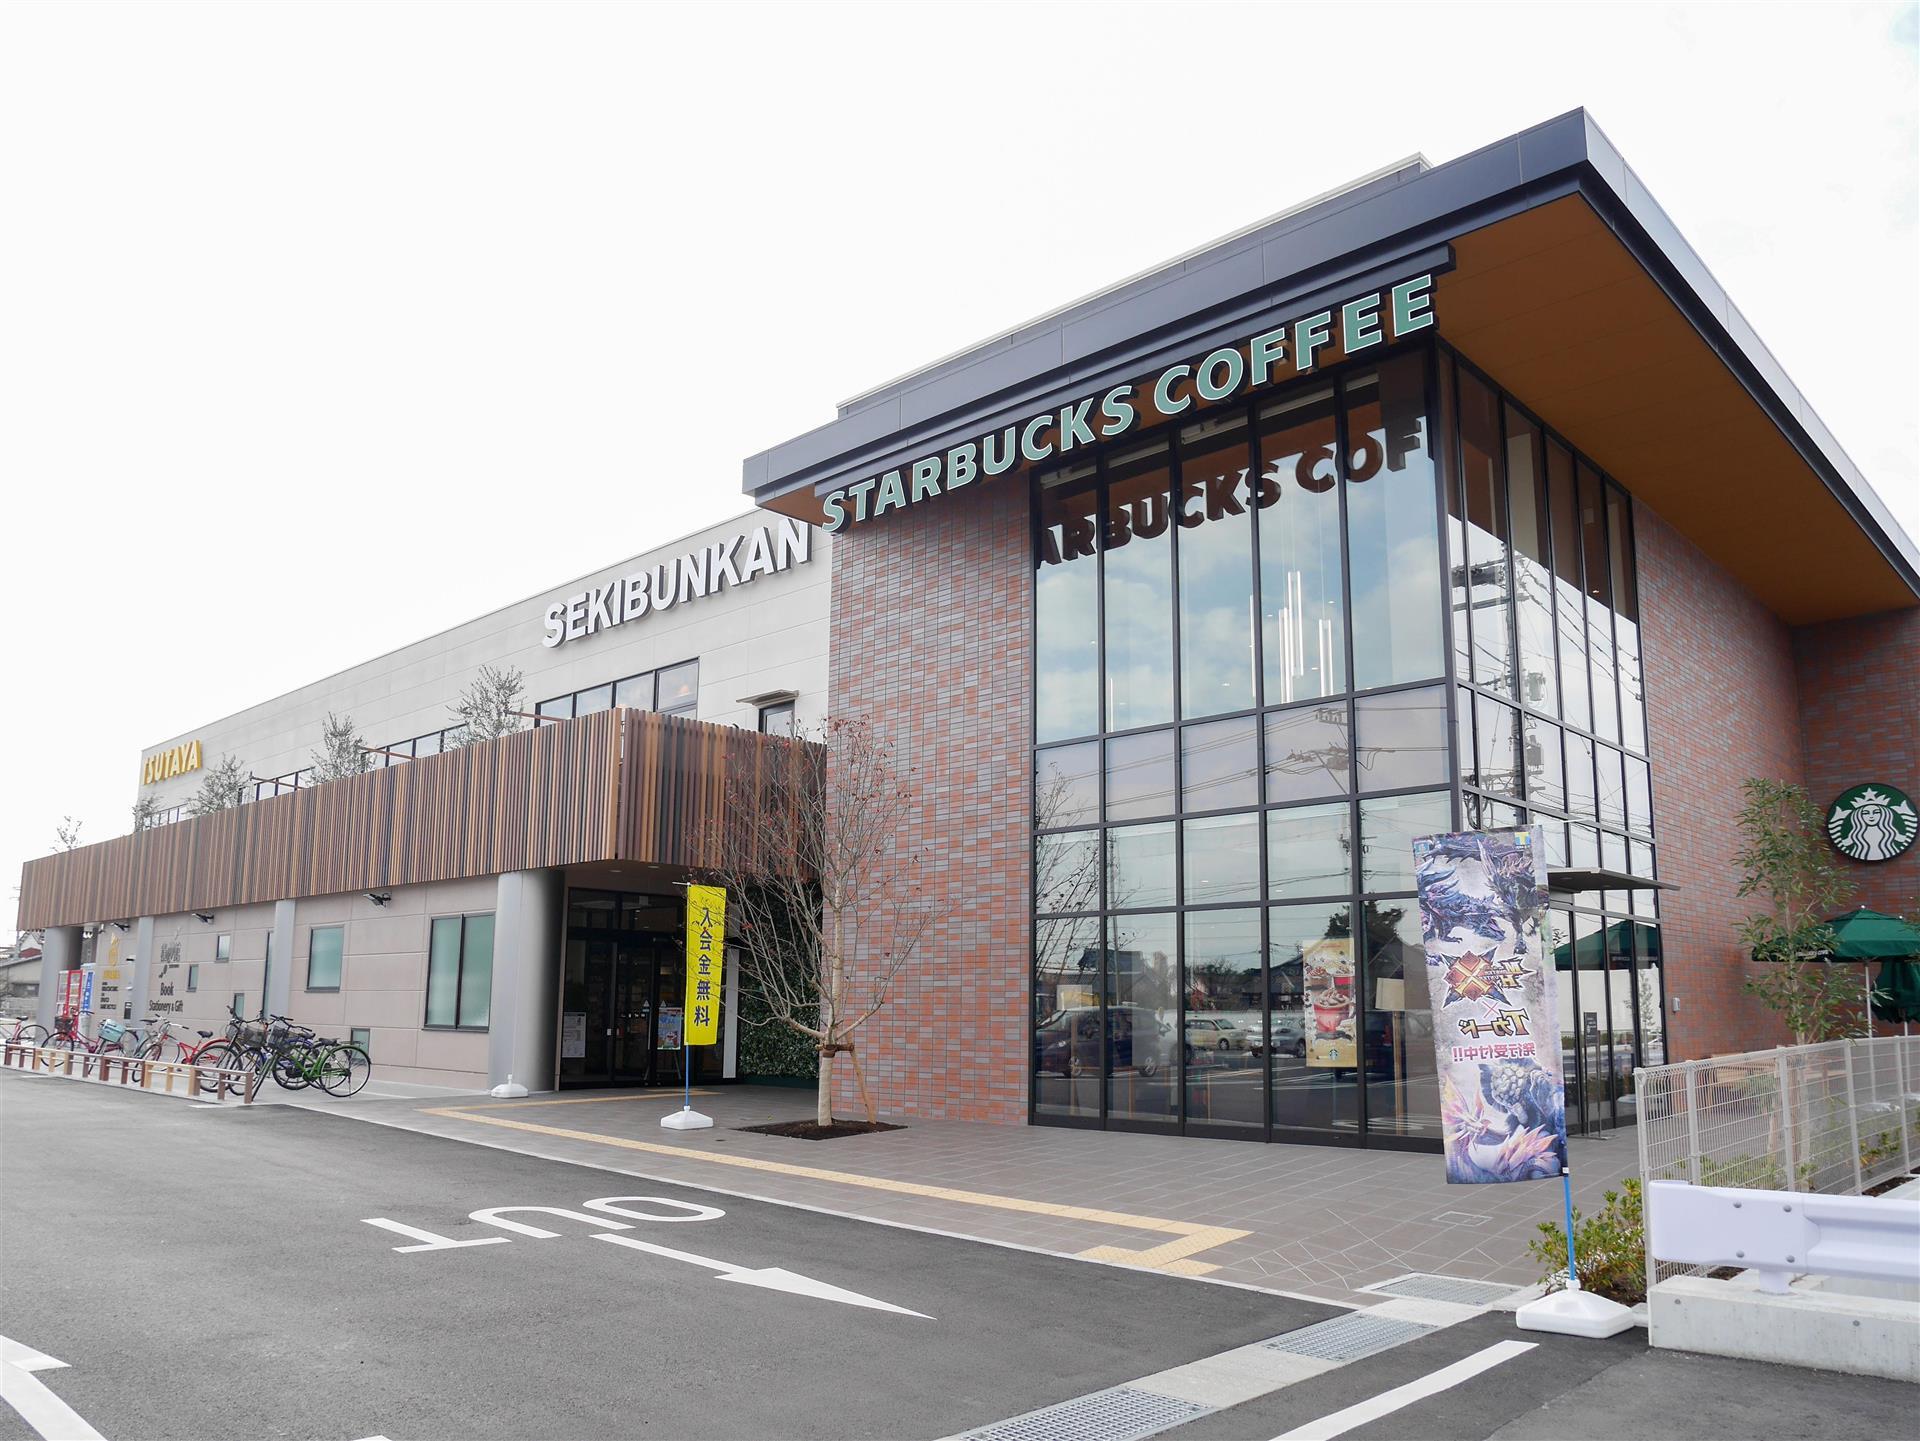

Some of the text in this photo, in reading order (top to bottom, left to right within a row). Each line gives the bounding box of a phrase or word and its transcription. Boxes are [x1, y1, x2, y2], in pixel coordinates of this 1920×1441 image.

[820, 273, 1436, 534] STARBUCKS COFFEE
[541, 518, 813, 649] SEKIBUNKAN
[160, 982, 175, 996] Book
[694, 907, 713, 1027] 入会金無料
[360, 1196, 726, 1254] OUT
